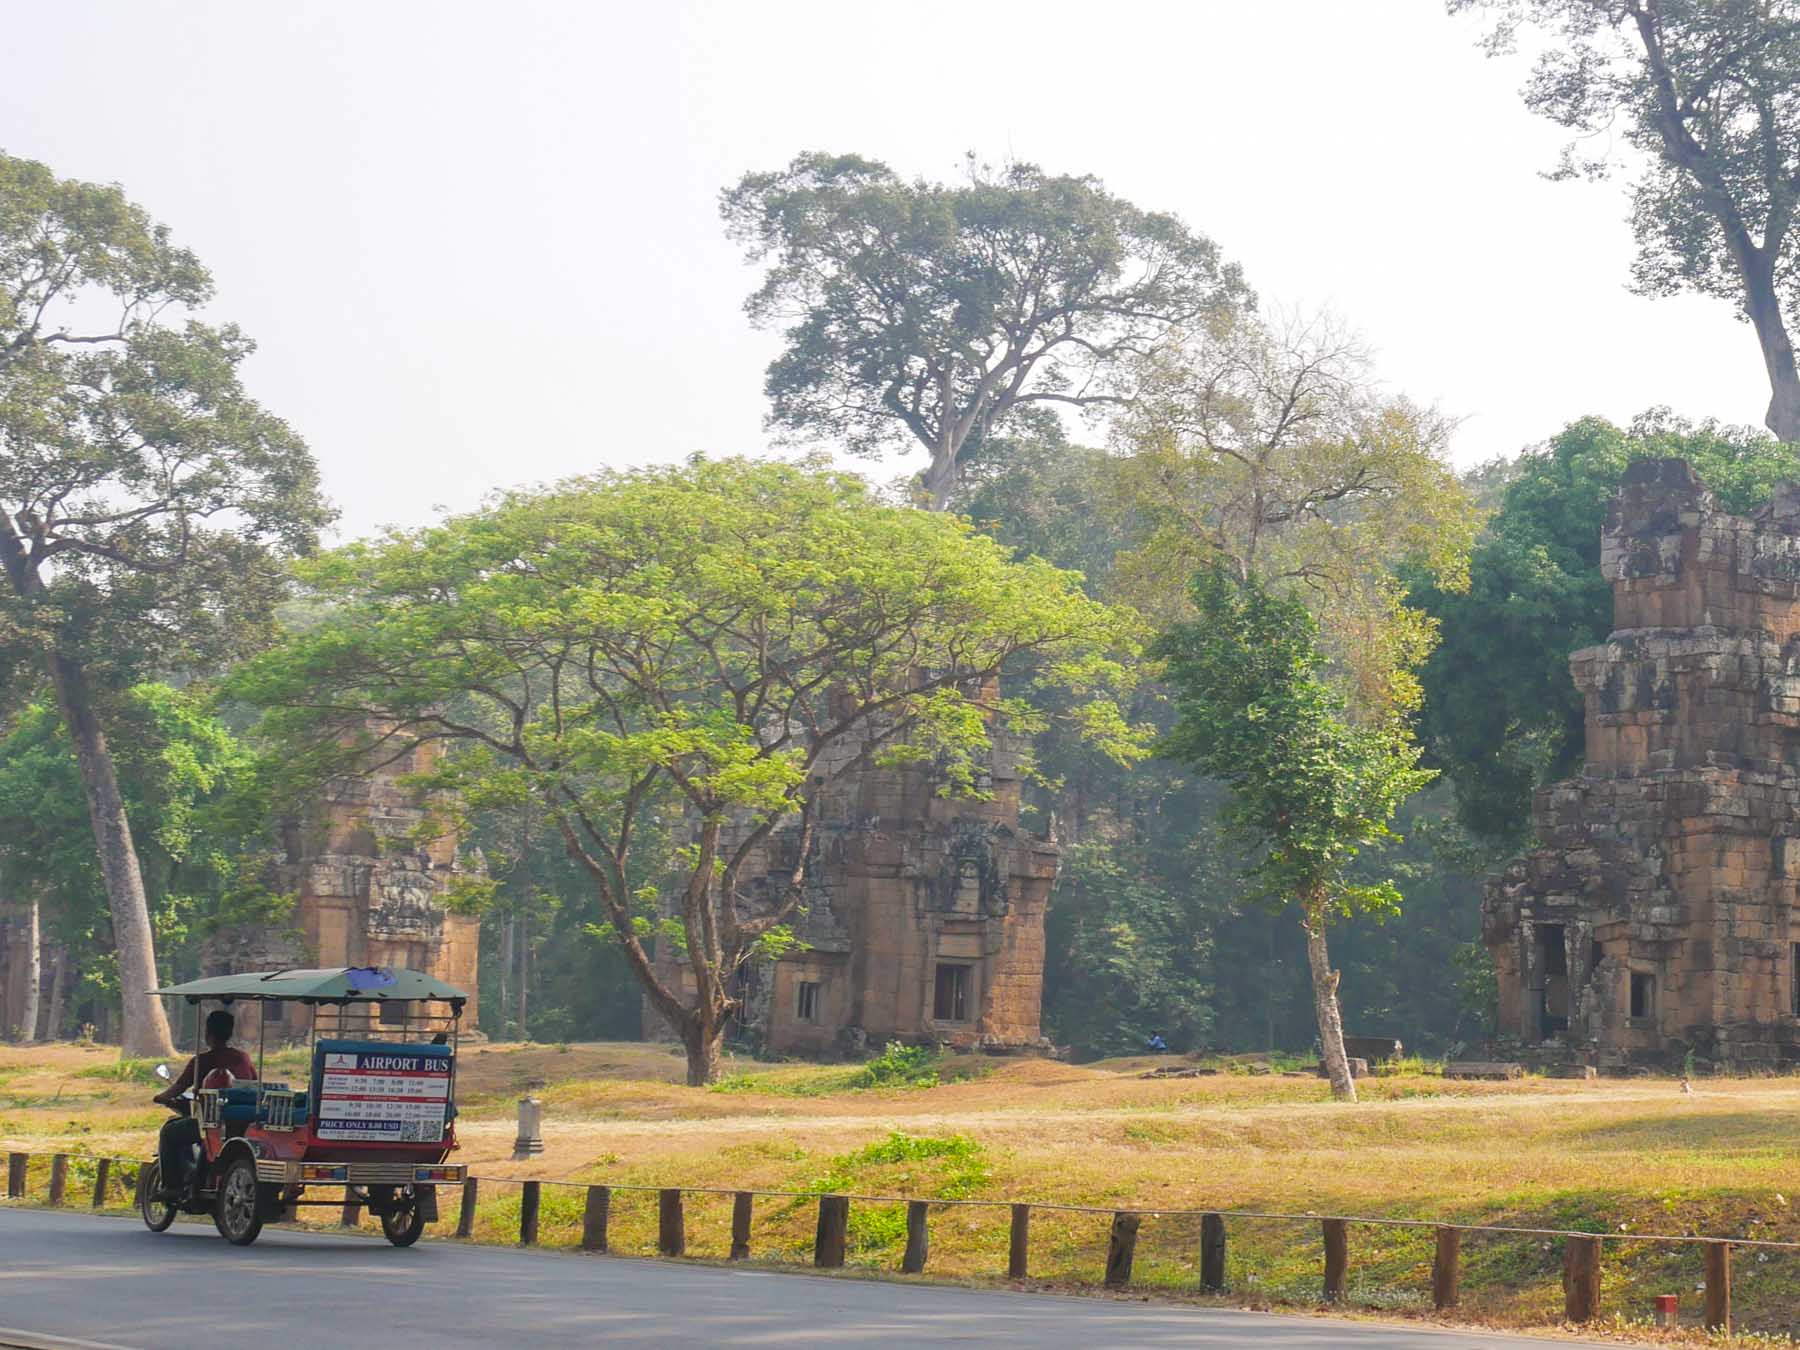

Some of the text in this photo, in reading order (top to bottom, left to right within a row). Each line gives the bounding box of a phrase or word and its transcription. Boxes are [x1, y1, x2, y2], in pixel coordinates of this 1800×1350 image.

[361, 1056, 448, 1072] AIRPORT BUS
[320, 1120, 346, 1129] PRICE
[346, 1120, 367, 1129] ONLY
[383, 1121, 399, 1130] USD
